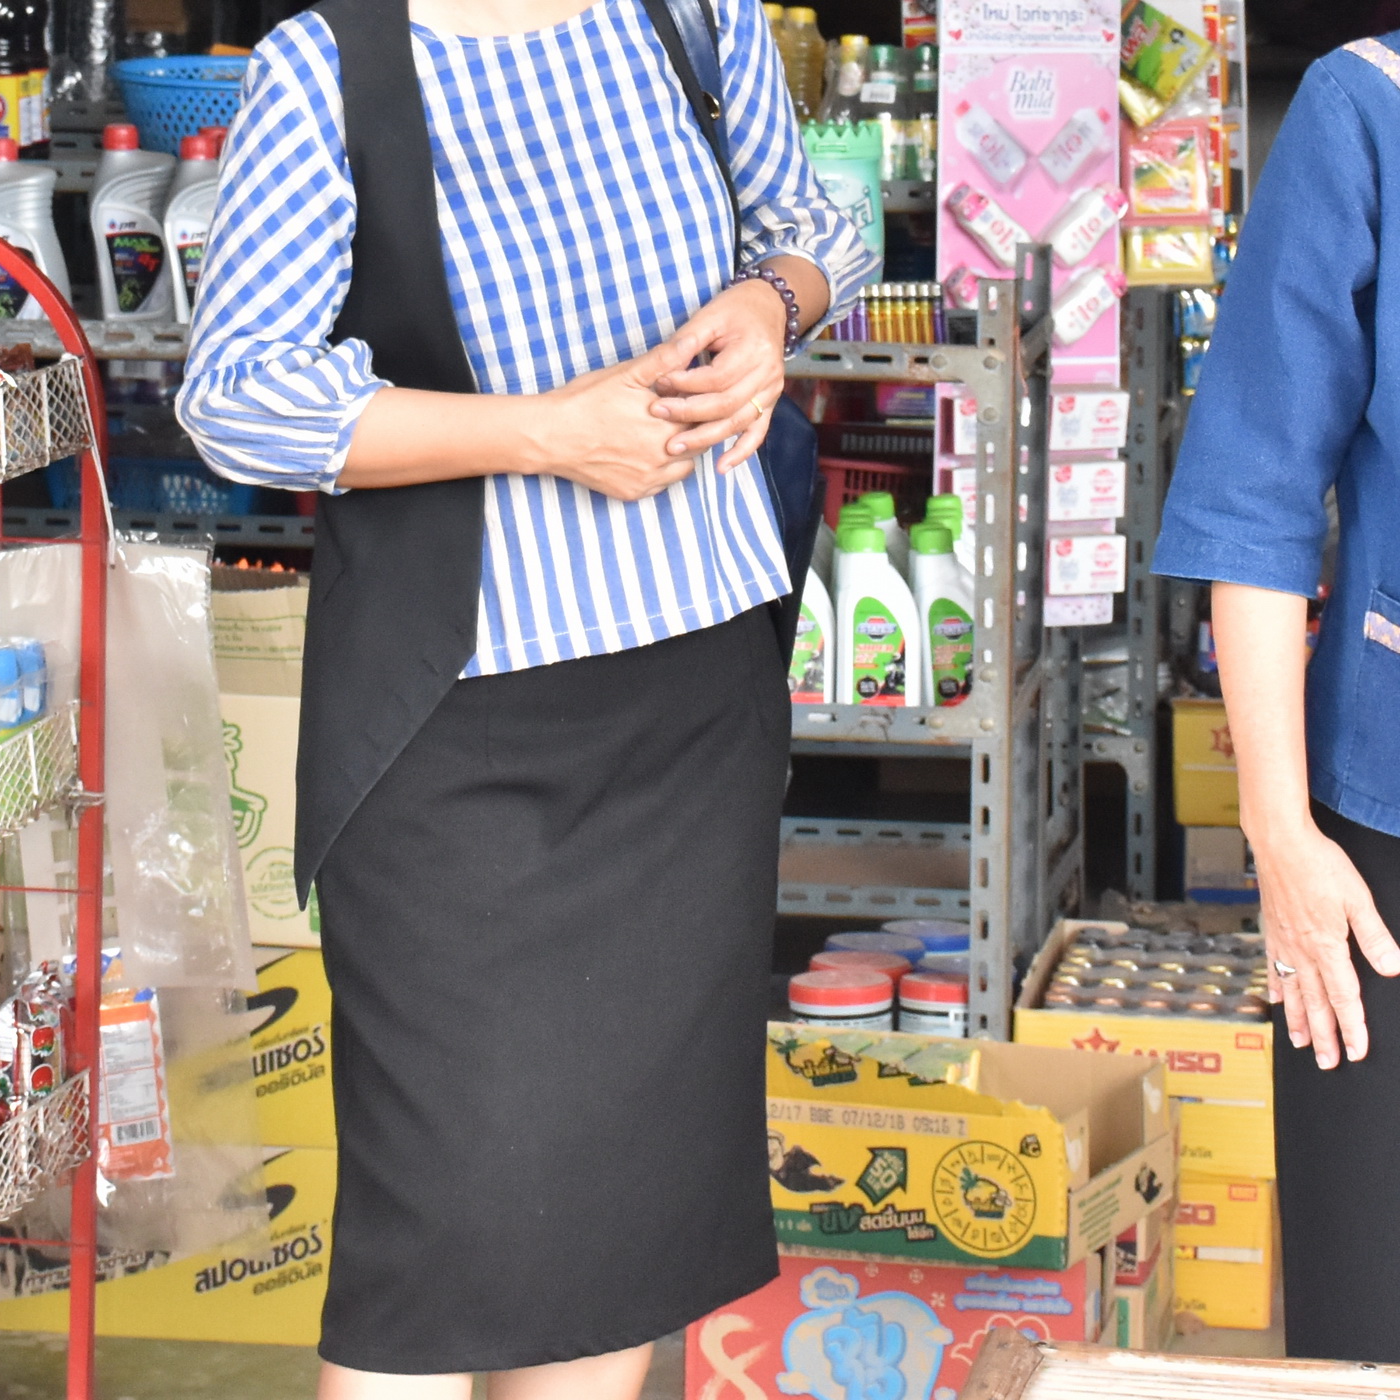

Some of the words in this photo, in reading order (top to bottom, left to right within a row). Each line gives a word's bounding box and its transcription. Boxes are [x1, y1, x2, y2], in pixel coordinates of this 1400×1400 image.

[1011, 70, 1054, 93] Babi
[195, 1226, 323, 1294] สปอนซอร์
